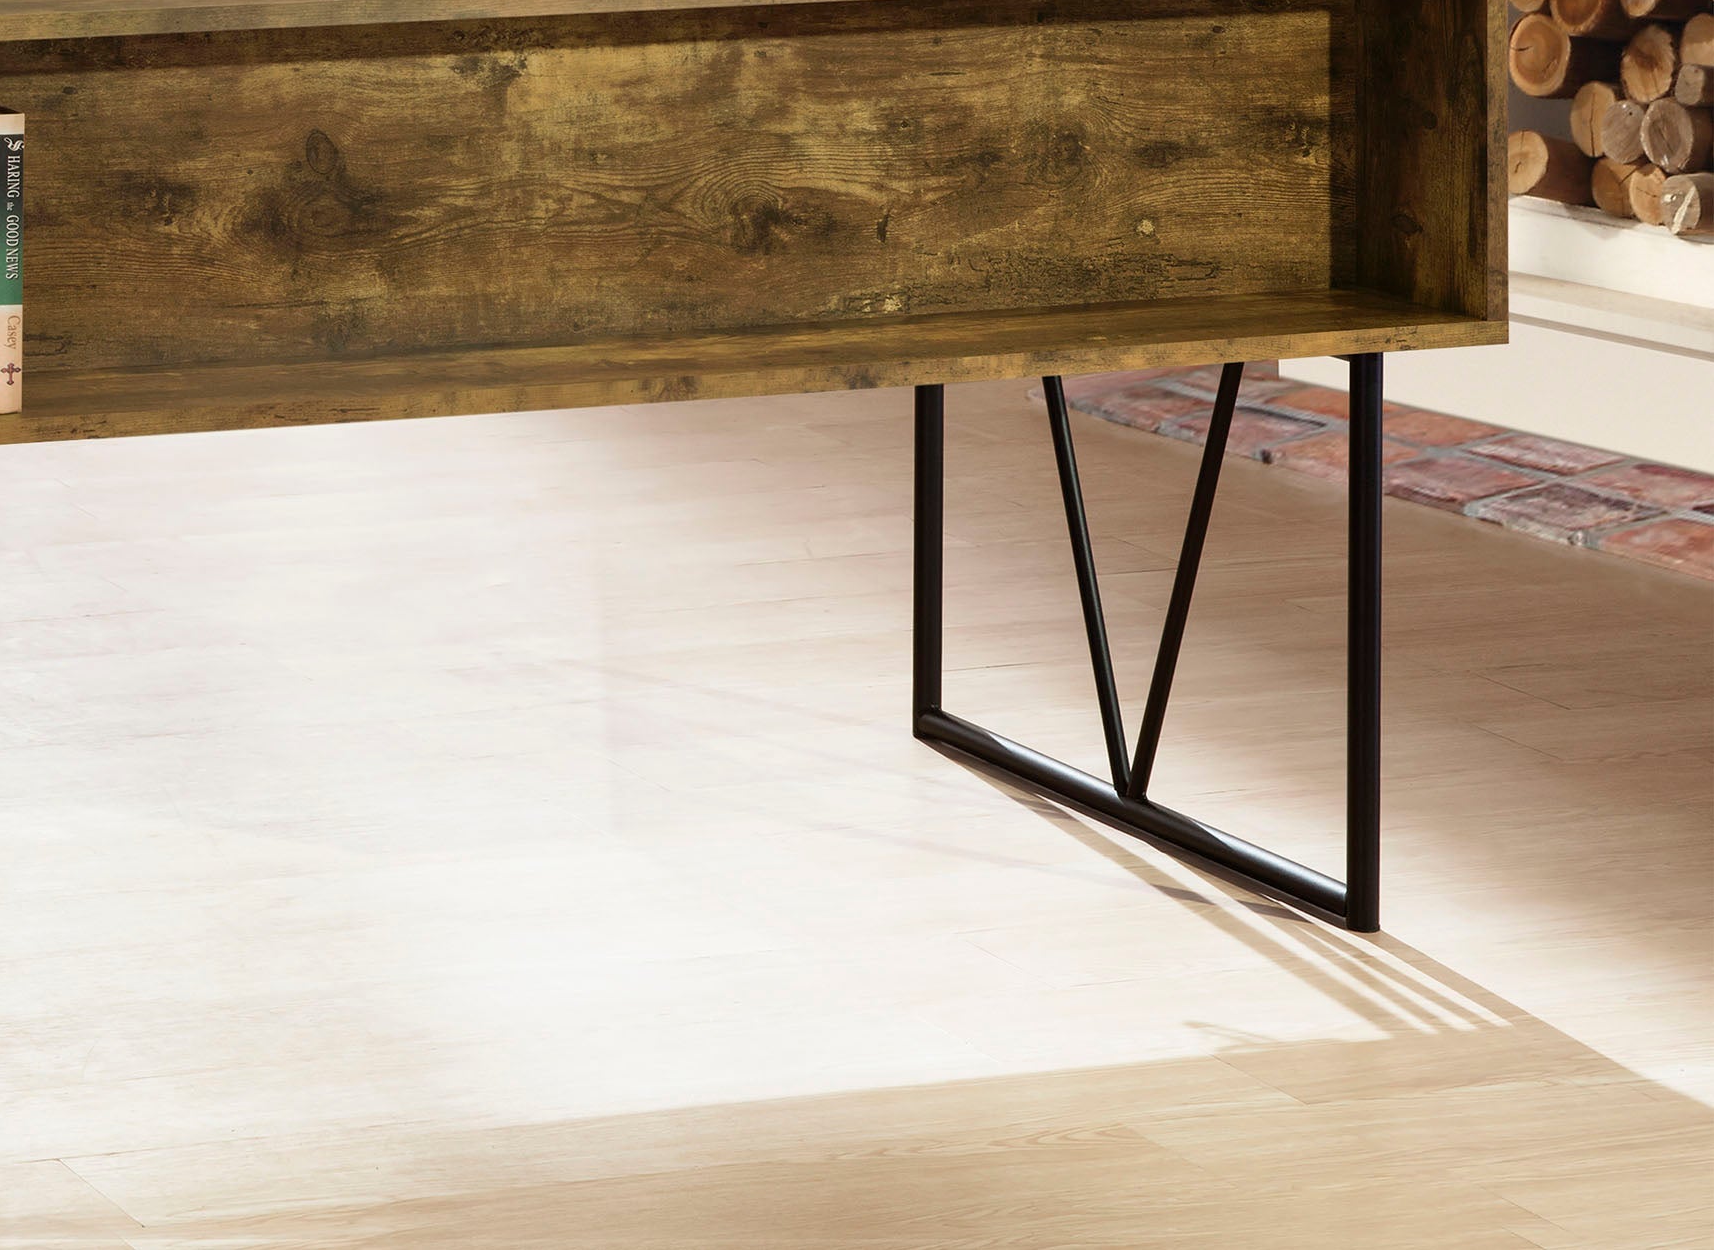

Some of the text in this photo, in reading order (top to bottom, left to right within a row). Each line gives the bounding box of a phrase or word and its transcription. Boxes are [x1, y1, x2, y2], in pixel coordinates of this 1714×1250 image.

[6, 214, 20, 252] GOOD
[6, 253, 19, 280] NEWS
[6, 315, 21, 350] Casey
